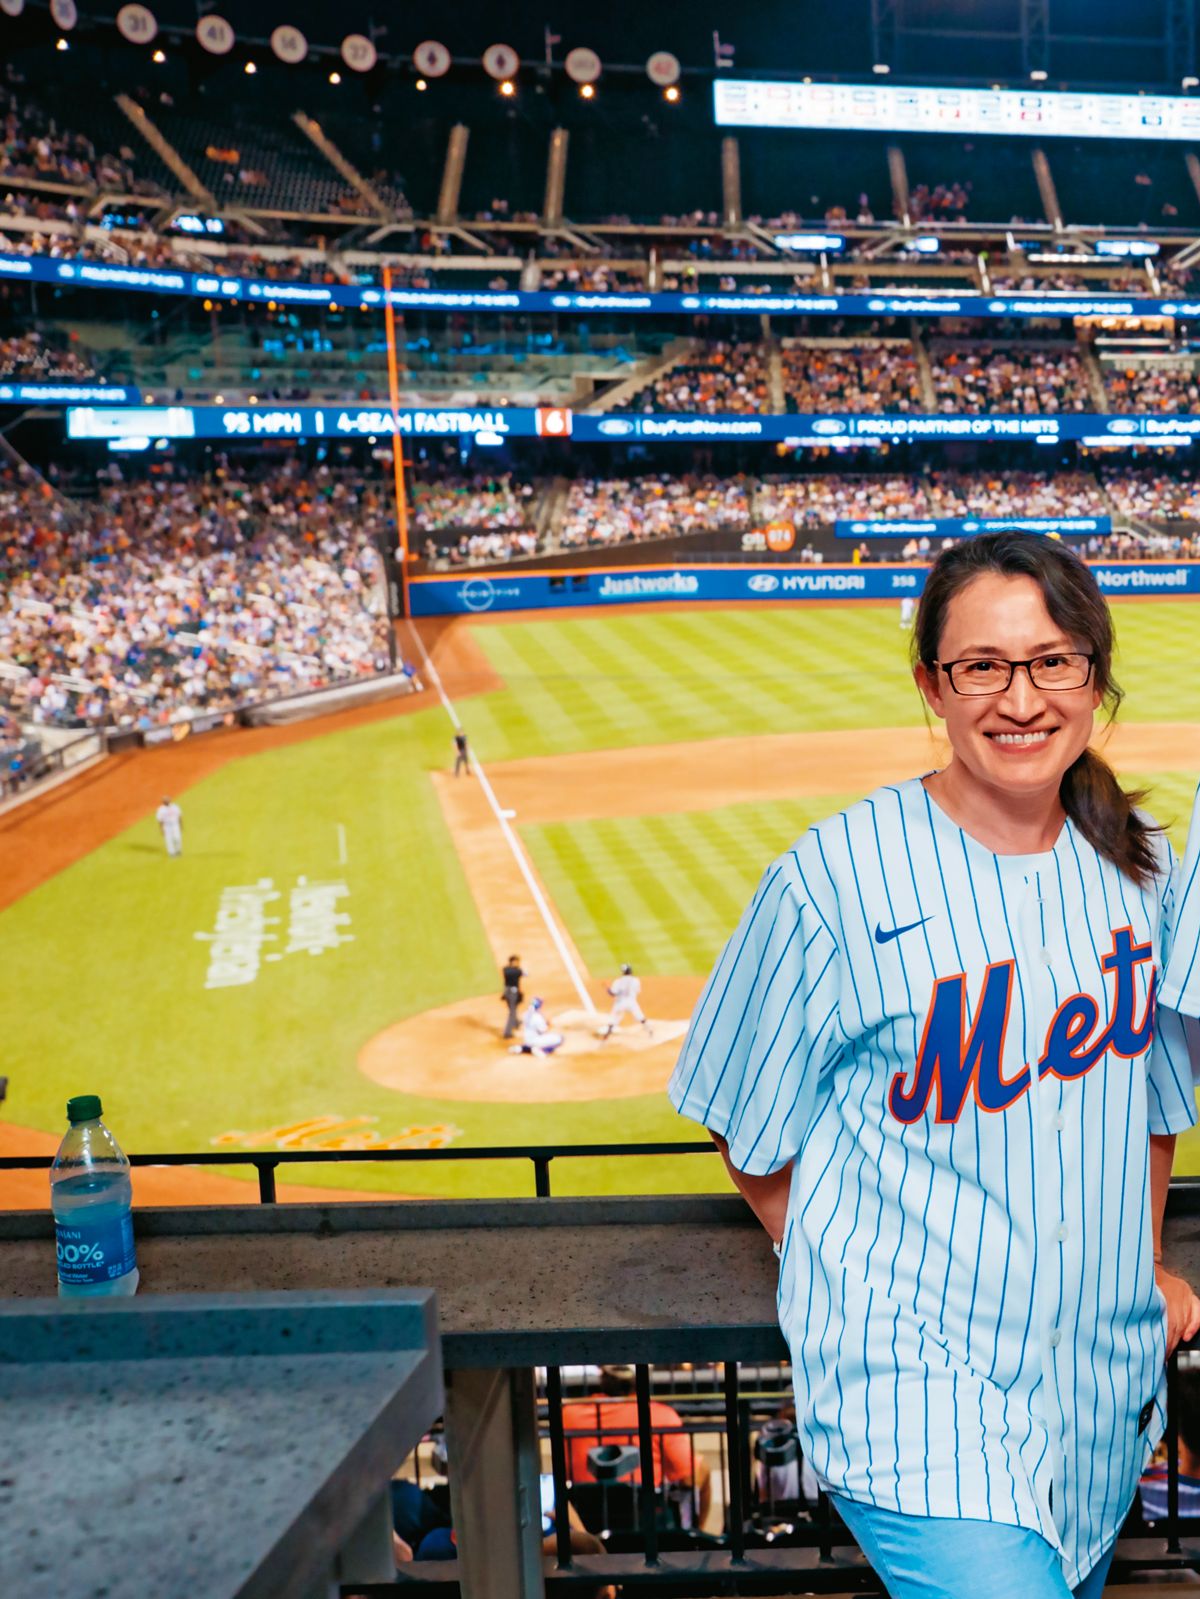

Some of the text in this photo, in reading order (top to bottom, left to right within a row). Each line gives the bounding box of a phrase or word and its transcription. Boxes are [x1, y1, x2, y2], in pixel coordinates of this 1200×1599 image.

[222, 411, 251, 434] 95
[252, 411, 303, 434] MPH
[413, 411, 510, 433] FASTBALL
[599, 572, 699, 596] Justworks
[782, 575, 866, 591] HYUNDAI
[1096, 568, 1188, 587] Northwell
[888, 924, 1157, 1125] Met
